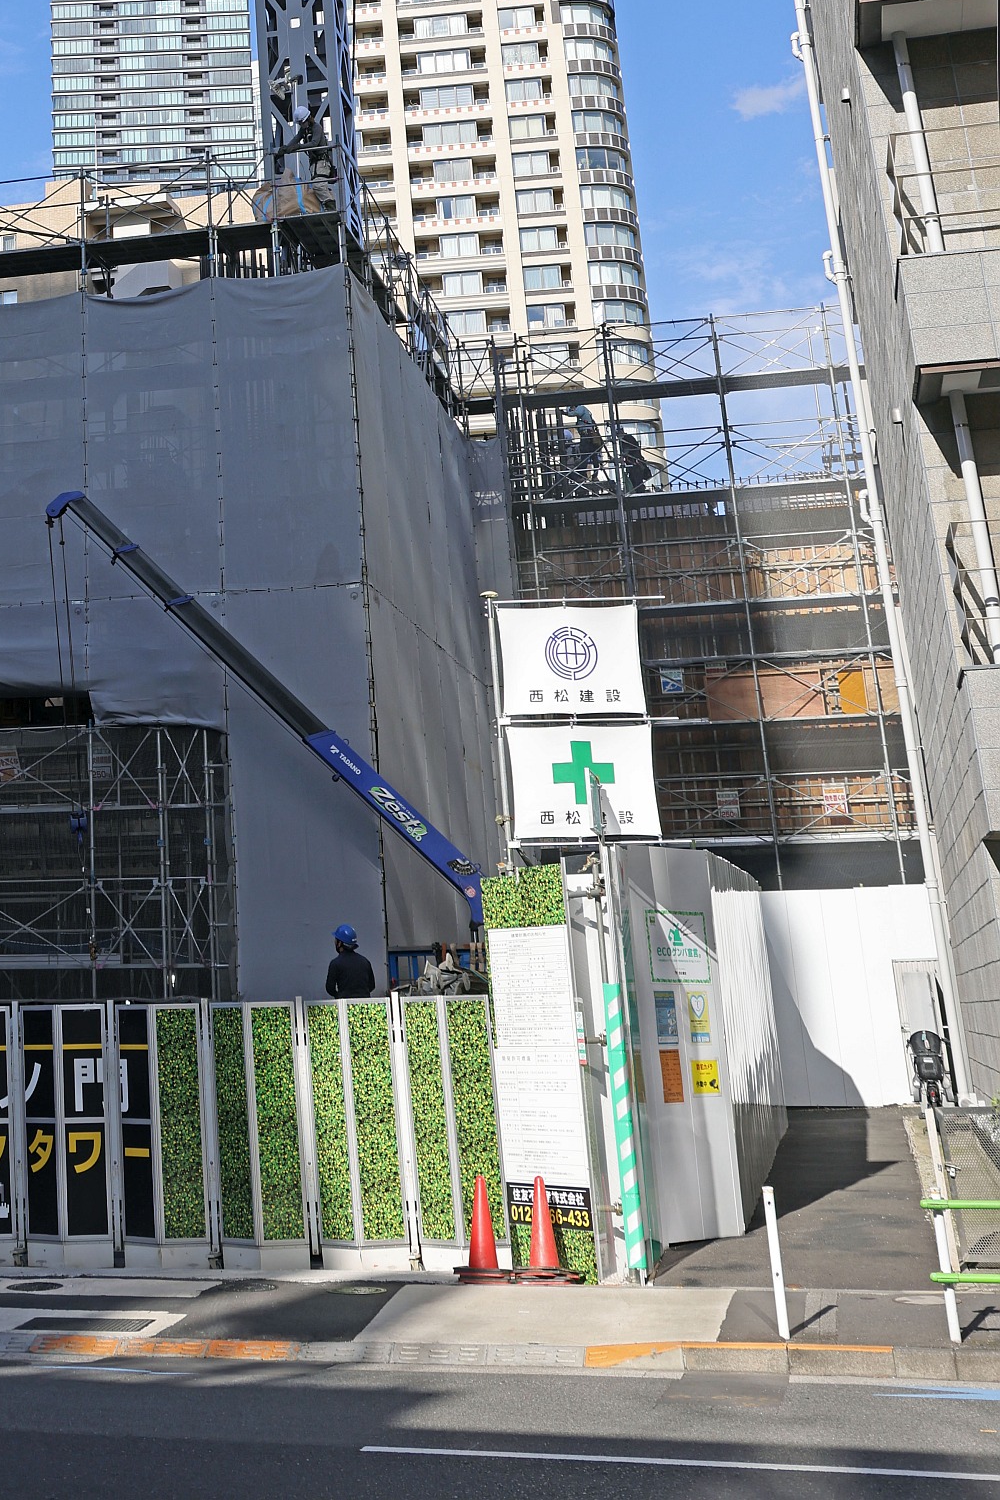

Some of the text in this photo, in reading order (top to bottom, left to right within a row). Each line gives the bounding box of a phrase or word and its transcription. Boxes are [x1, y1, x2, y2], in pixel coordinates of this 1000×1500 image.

[529, 689, 621, 703] 西松建設
[339, 752, 362, 775] TADANO
[367, 786, 422, 830] Zest
[512, 1188, 585, 1206] 住友不産株式会社
